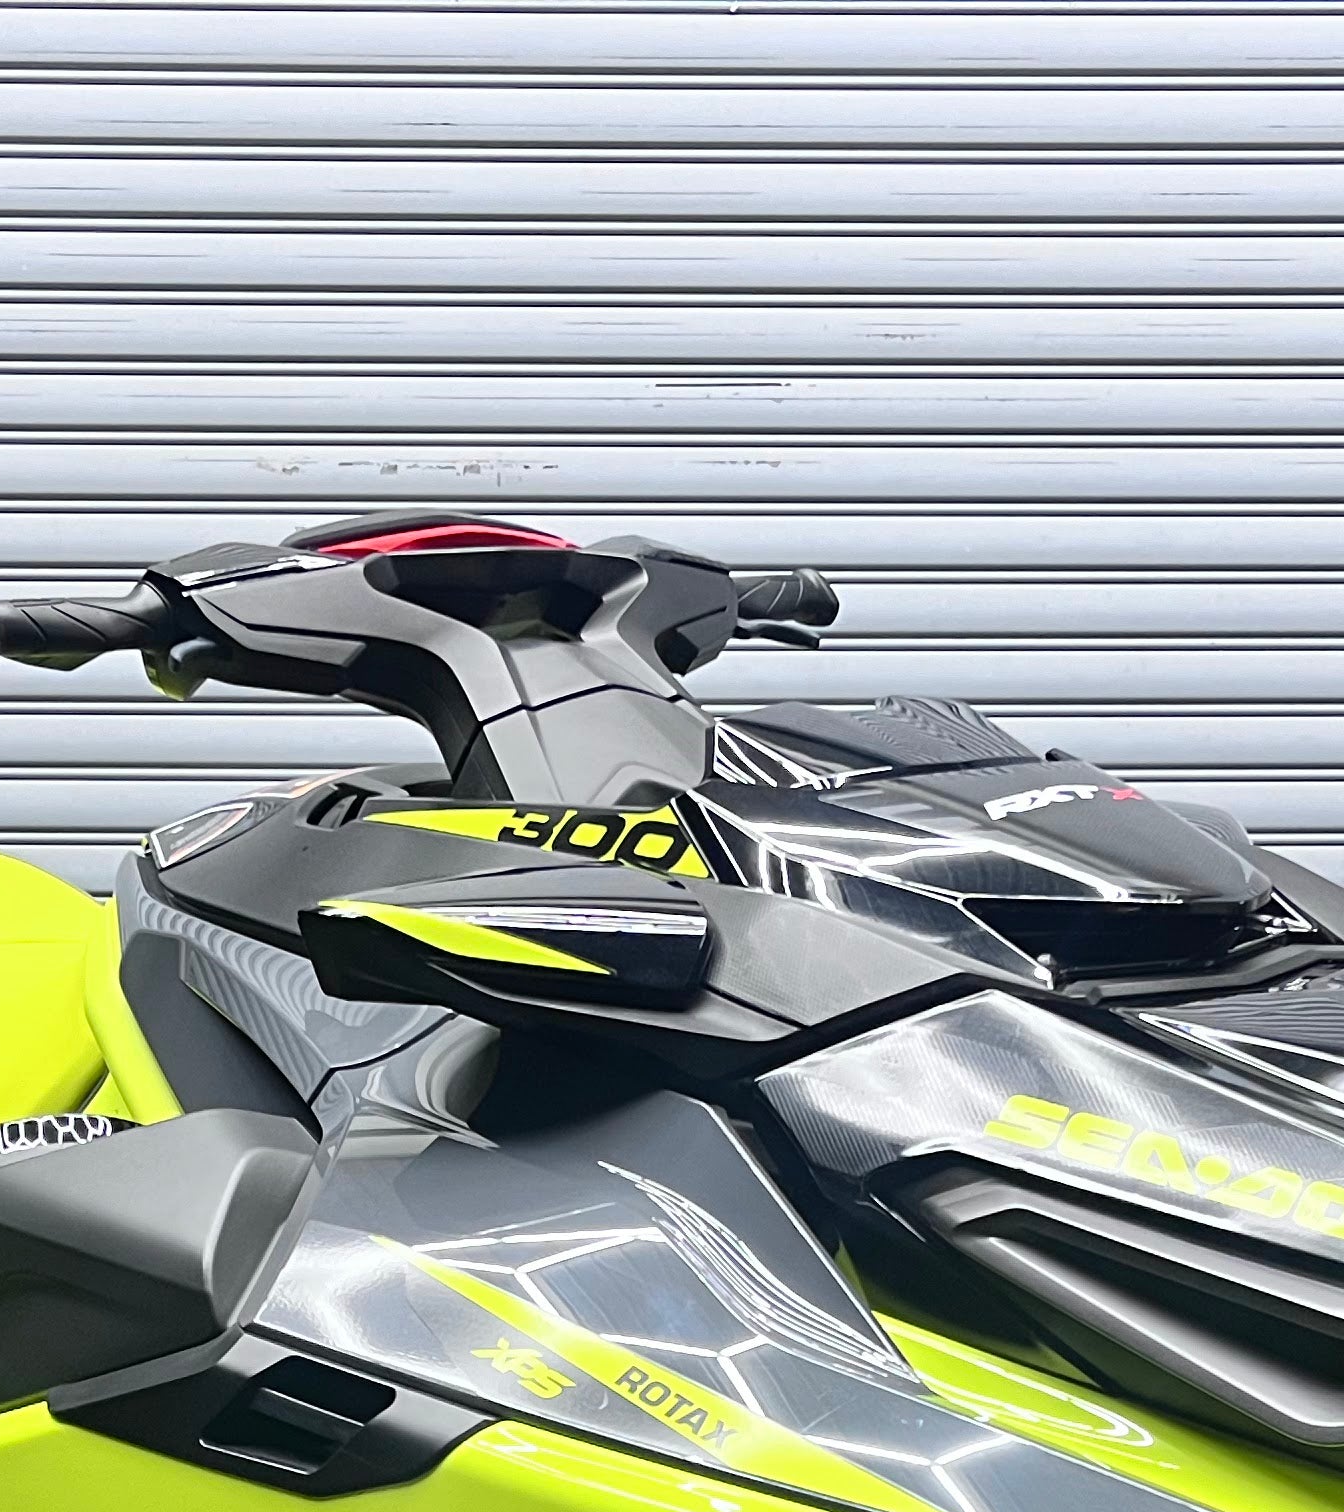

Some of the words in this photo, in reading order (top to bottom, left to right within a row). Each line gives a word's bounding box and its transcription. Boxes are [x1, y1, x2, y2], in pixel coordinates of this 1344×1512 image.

[983, 784, 1099, 821] RXT
[498, 809, 691, 871] 300
[470, 1337, 577, 1399] XPS
[614, 1365, 738, 1449] ROTAX
